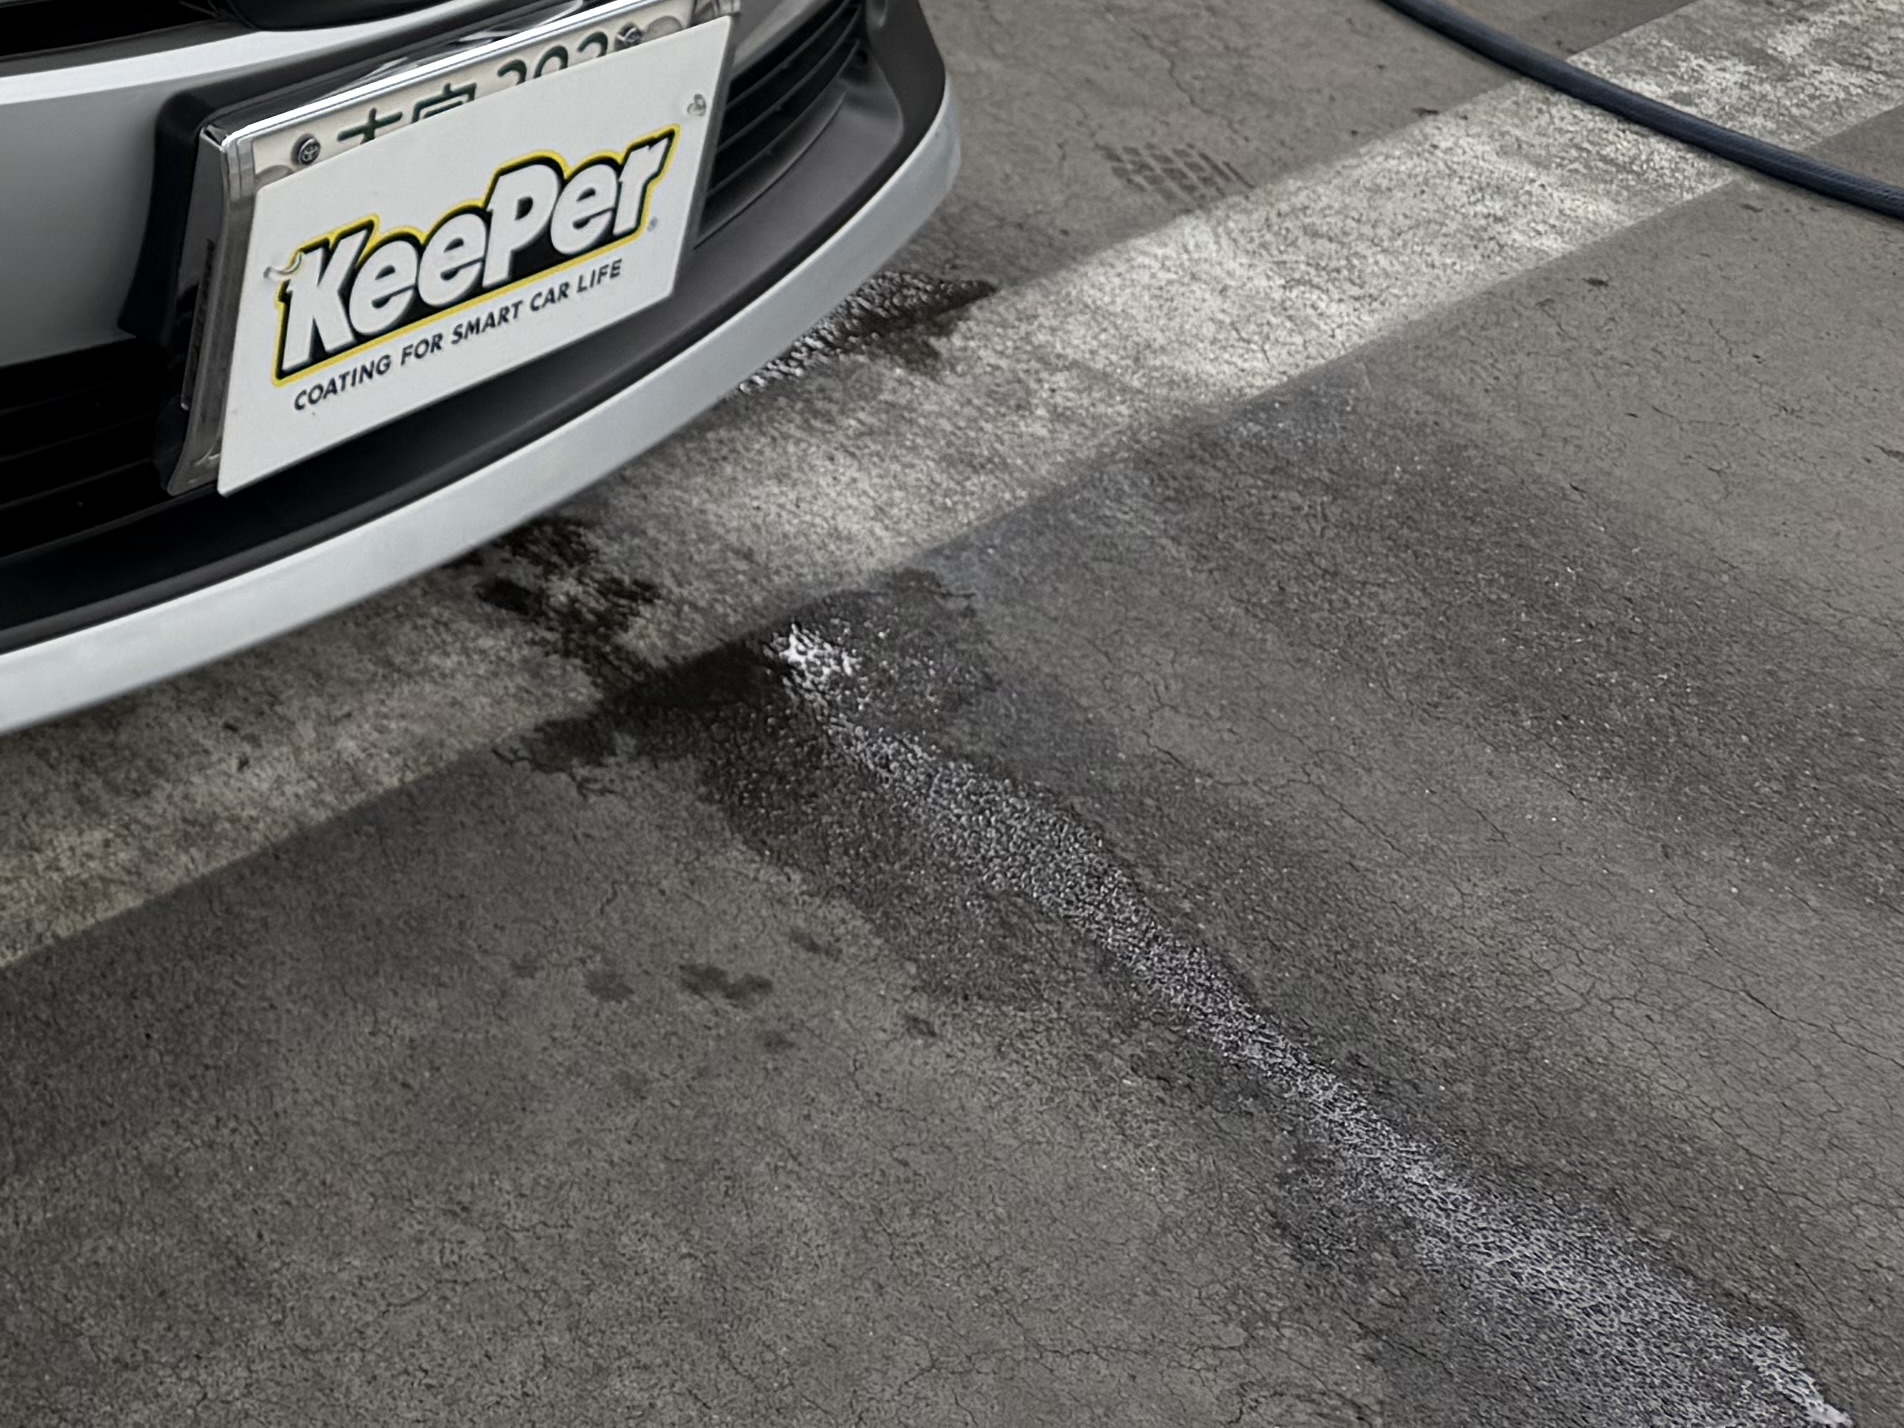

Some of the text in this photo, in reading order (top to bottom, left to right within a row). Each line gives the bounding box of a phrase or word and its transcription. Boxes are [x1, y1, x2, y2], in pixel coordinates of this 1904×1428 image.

[277, 128, 678, 380] KeePer
[293, 258, 623, 412] COATING FOR SMART CAR LIFE
